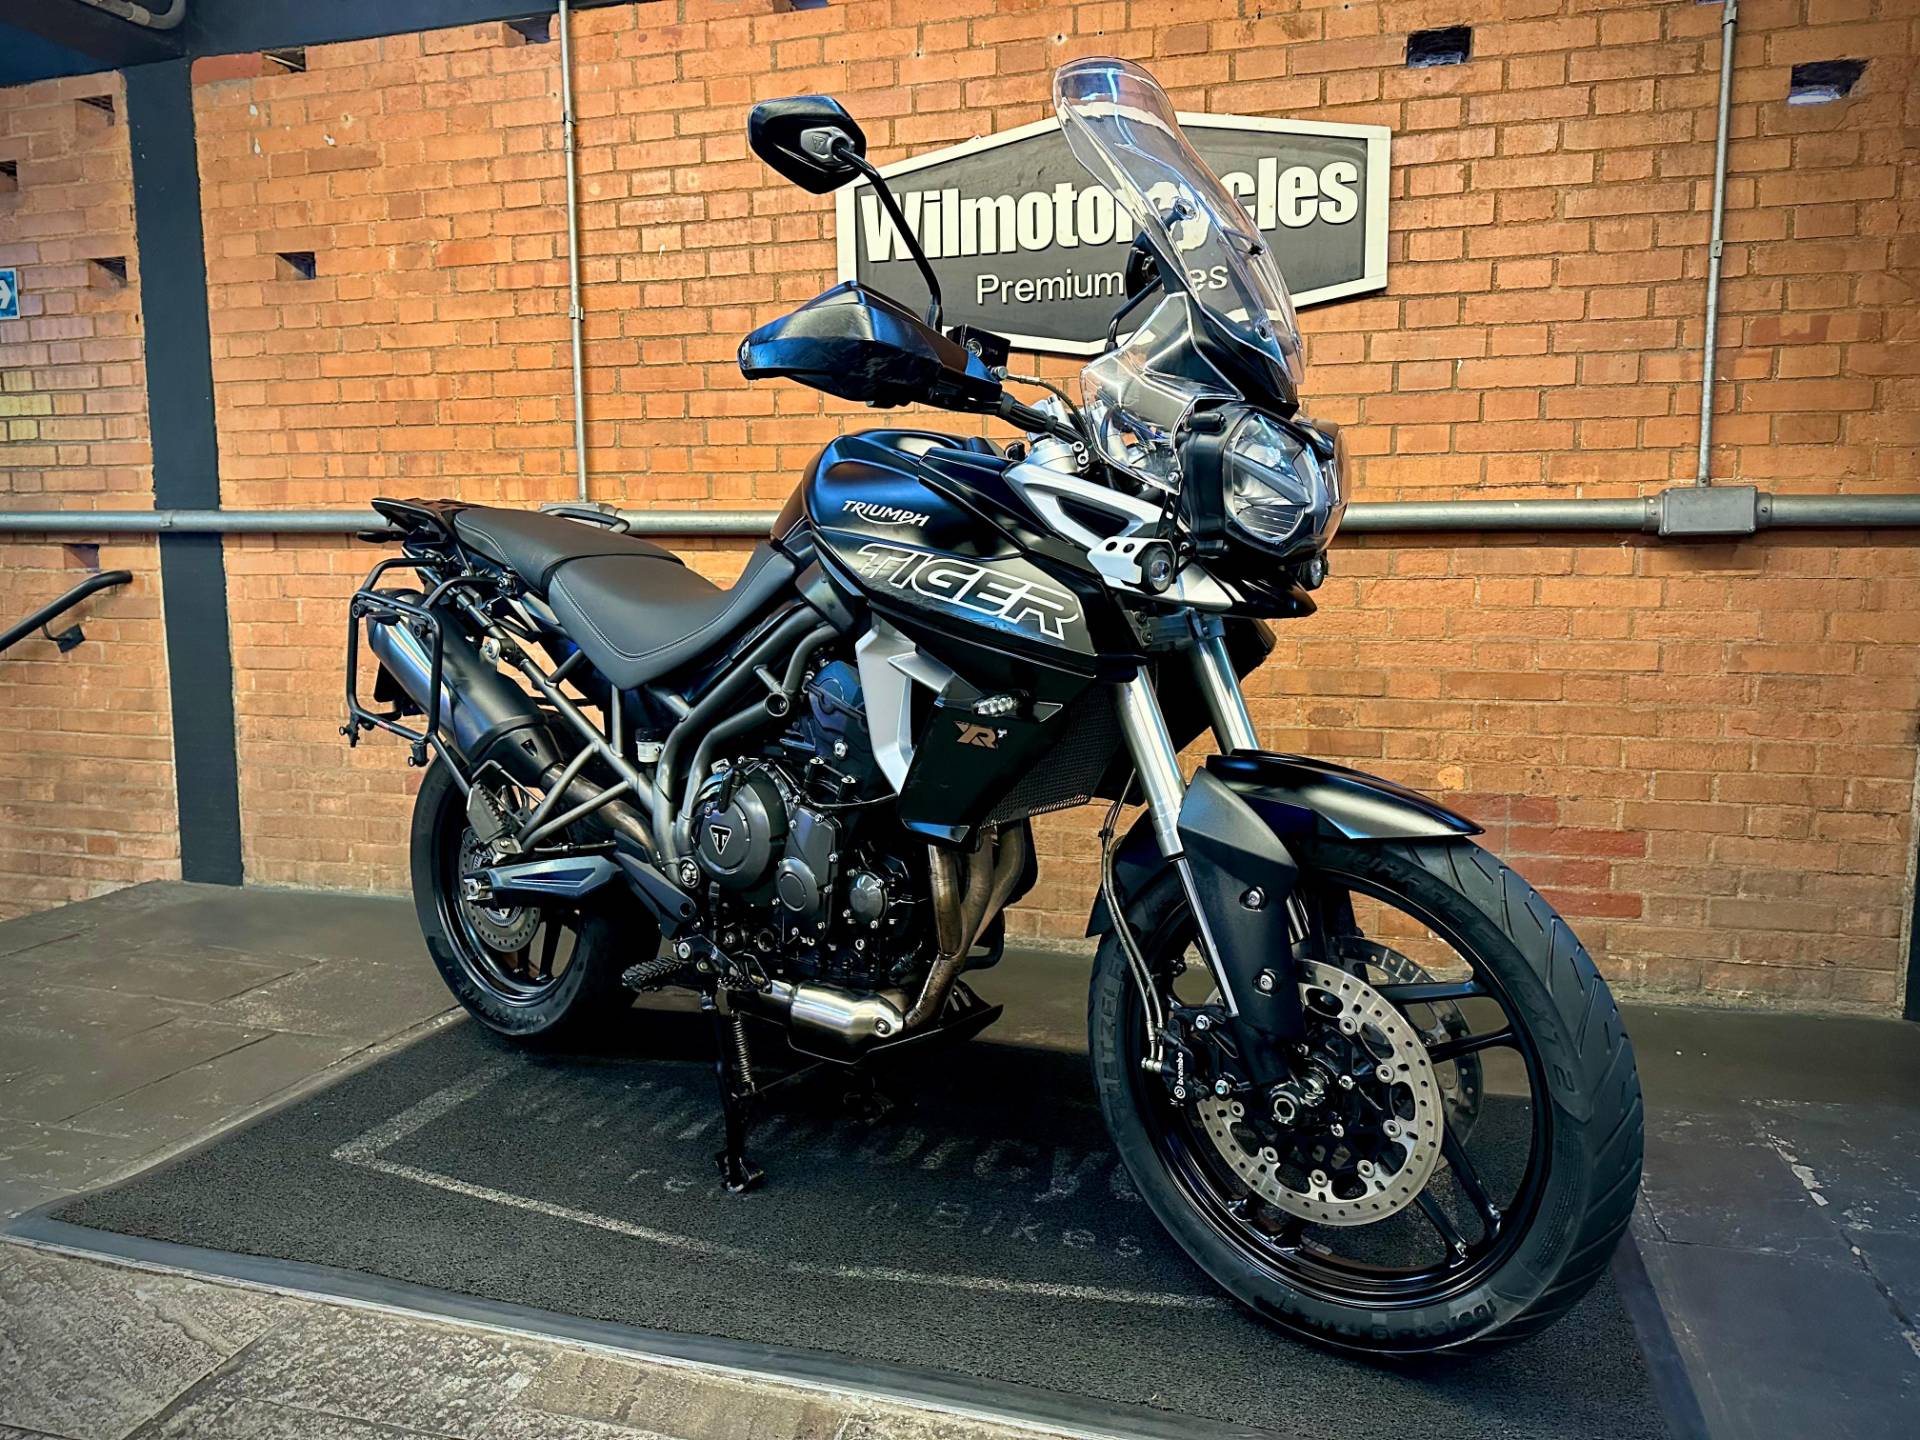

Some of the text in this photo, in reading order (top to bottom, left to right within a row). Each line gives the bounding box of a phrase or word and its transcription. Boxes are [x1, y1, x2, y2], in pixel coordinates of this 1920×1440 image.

[976, 267, 1124, 304] Premium
[842, 500, 930, 527] TRIUMPH
[856, 543, 1080, 641] TIGER
